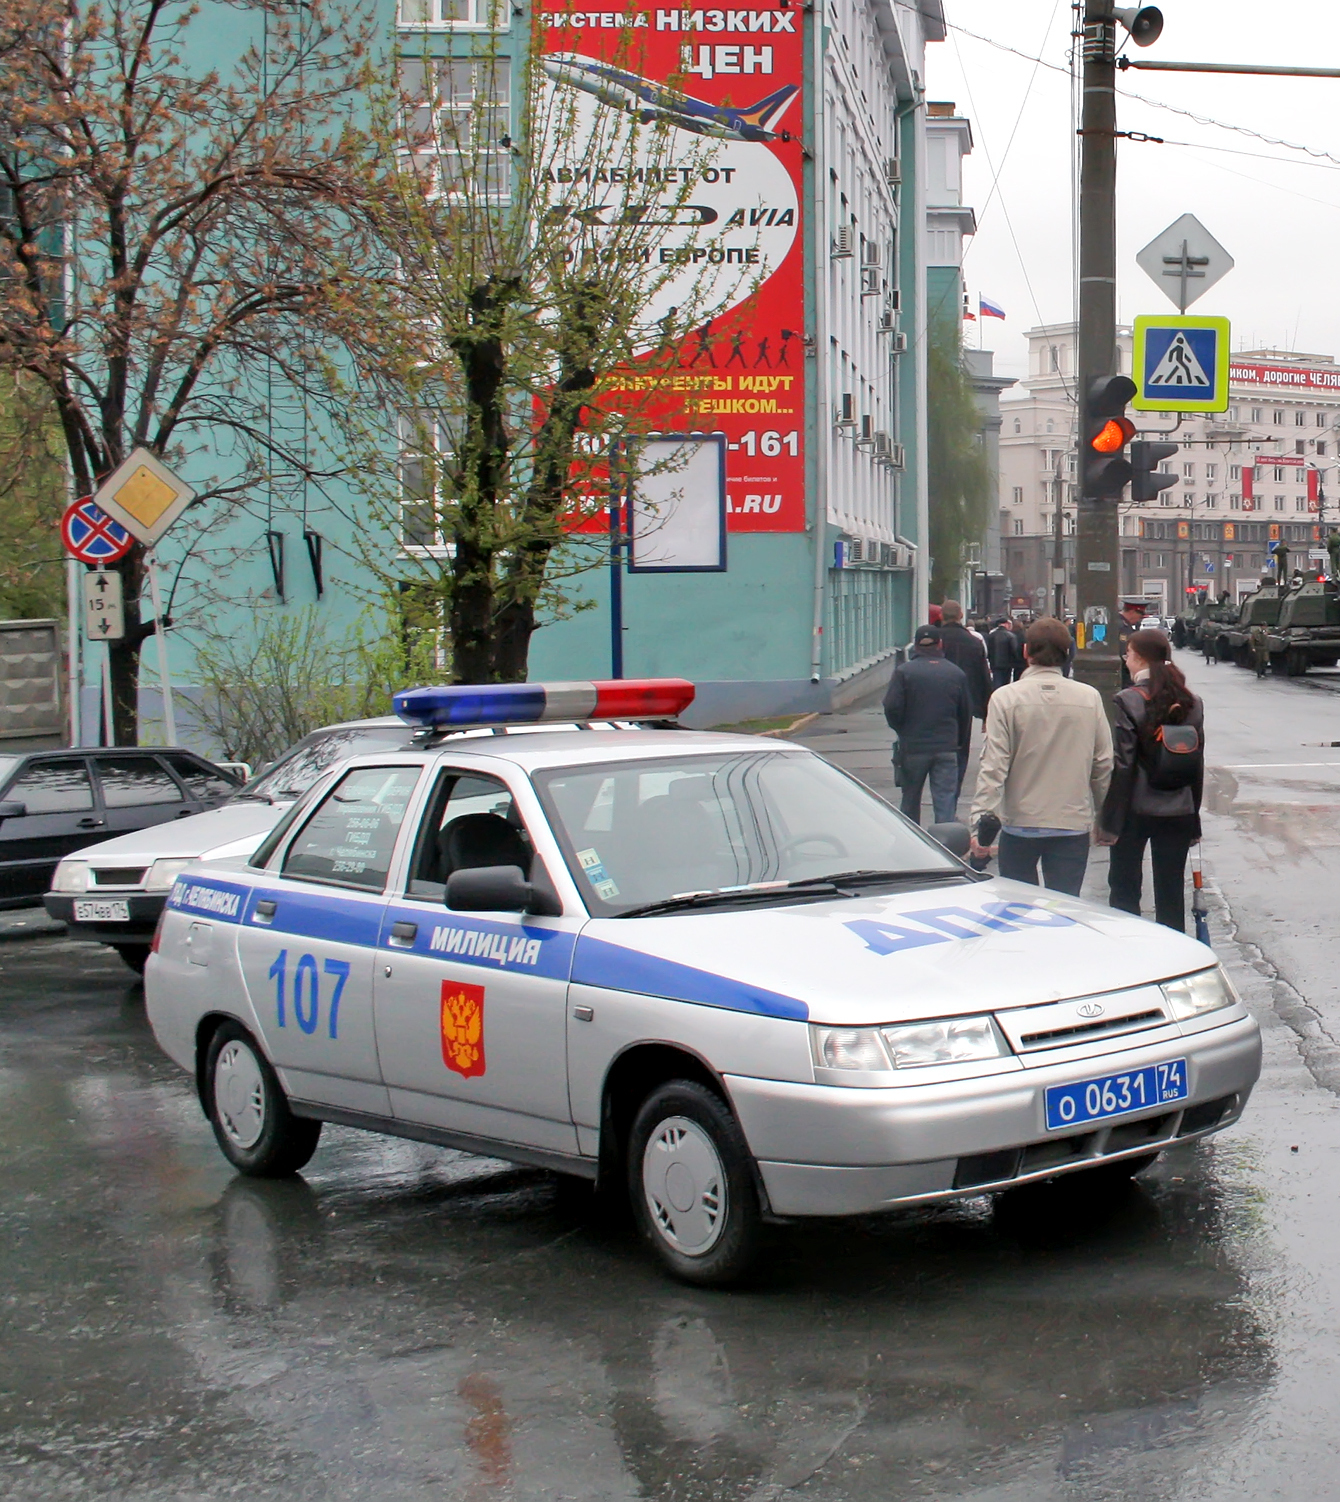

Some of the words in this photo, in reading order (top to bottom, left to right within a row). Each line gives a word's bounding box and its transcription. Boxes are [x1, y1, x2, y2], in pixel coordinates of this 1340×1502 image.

[540, 13, 648, 28] СИСТЕМА
[656, 10, 795, 33] НИЗКИХ
[682, 45, 773, 79] ЦЕН
[541, 167, 693, 183] АВИАБИЛЕТ
[701, 168, 735, 183] ОТ
[725, 208, 794, 227] AVIA
[659, 248, 760, 263] ЕВРОПЕ
[739, 376, 794, 393] ИДУТ
[727, 431, 798, 456] -161
[89, 599, 104, 610] 15
[187, 885, 240, 917] ЧЕЛЯБИНСКА
[842, 902, 1078, 956] ДПС
[430, 926, 542, 965] МИЛИЦИЯ
[269, 949, 351, 1039] 107
[1158, 1061, 1181, 1090] 74
[1086, 1077, 1147, 1113] 0631
[1162, 1088, 1179, 1100] RUS
